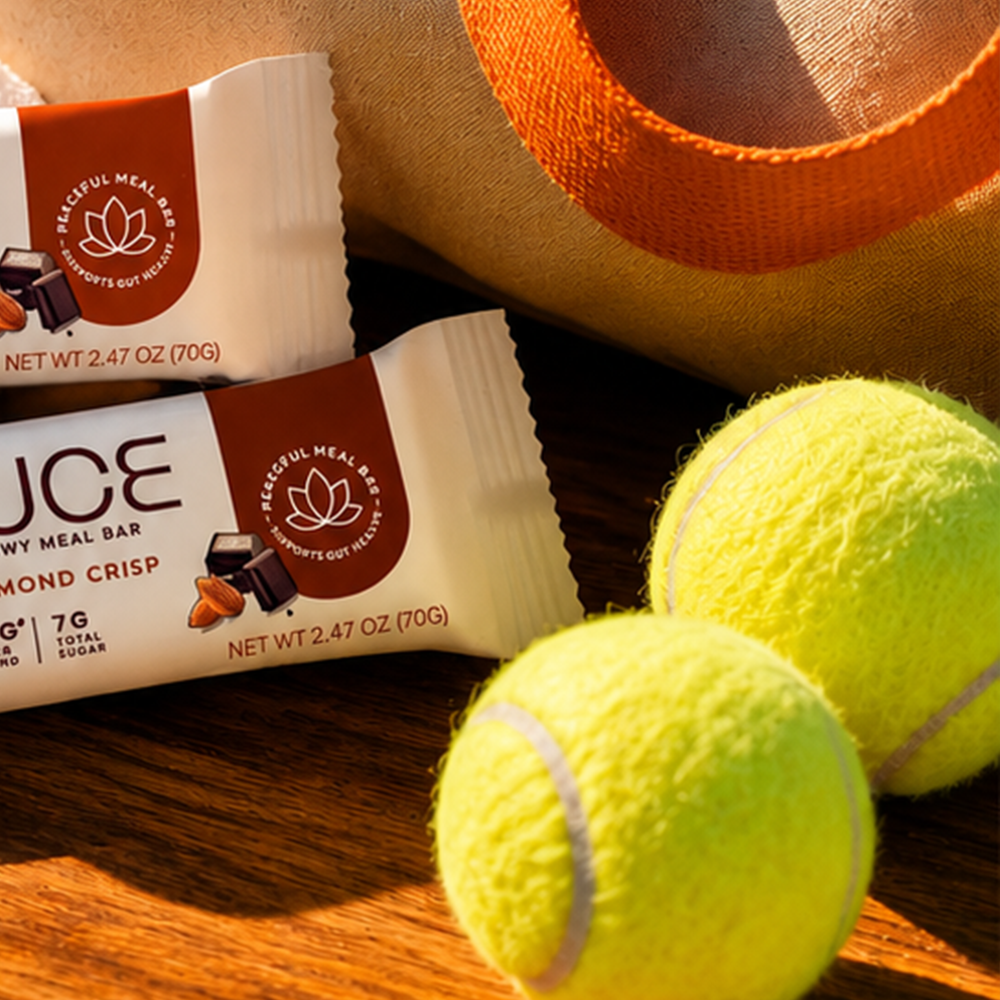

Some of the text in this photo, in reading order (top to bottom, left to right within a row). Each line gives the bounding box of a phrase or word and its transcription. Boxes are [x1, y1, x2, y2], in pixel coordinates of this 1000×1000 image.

[115, 173, 155, 198] MEAL
[4, 342, 221, 372] NET WT 2.47 OZ (70G)
[313, 445, 355, 467] MEAL
[39, 531, 94, 551] MEAL
[102, 522, 142, 541] BAR
[86, 555, 160, 584] CRISP
[51, 610, 88, 633] 7G
[228, 604, 449, 660] NET WT 2.47 OZ (70G)
[56, 632, 102, 647] TOTAL
